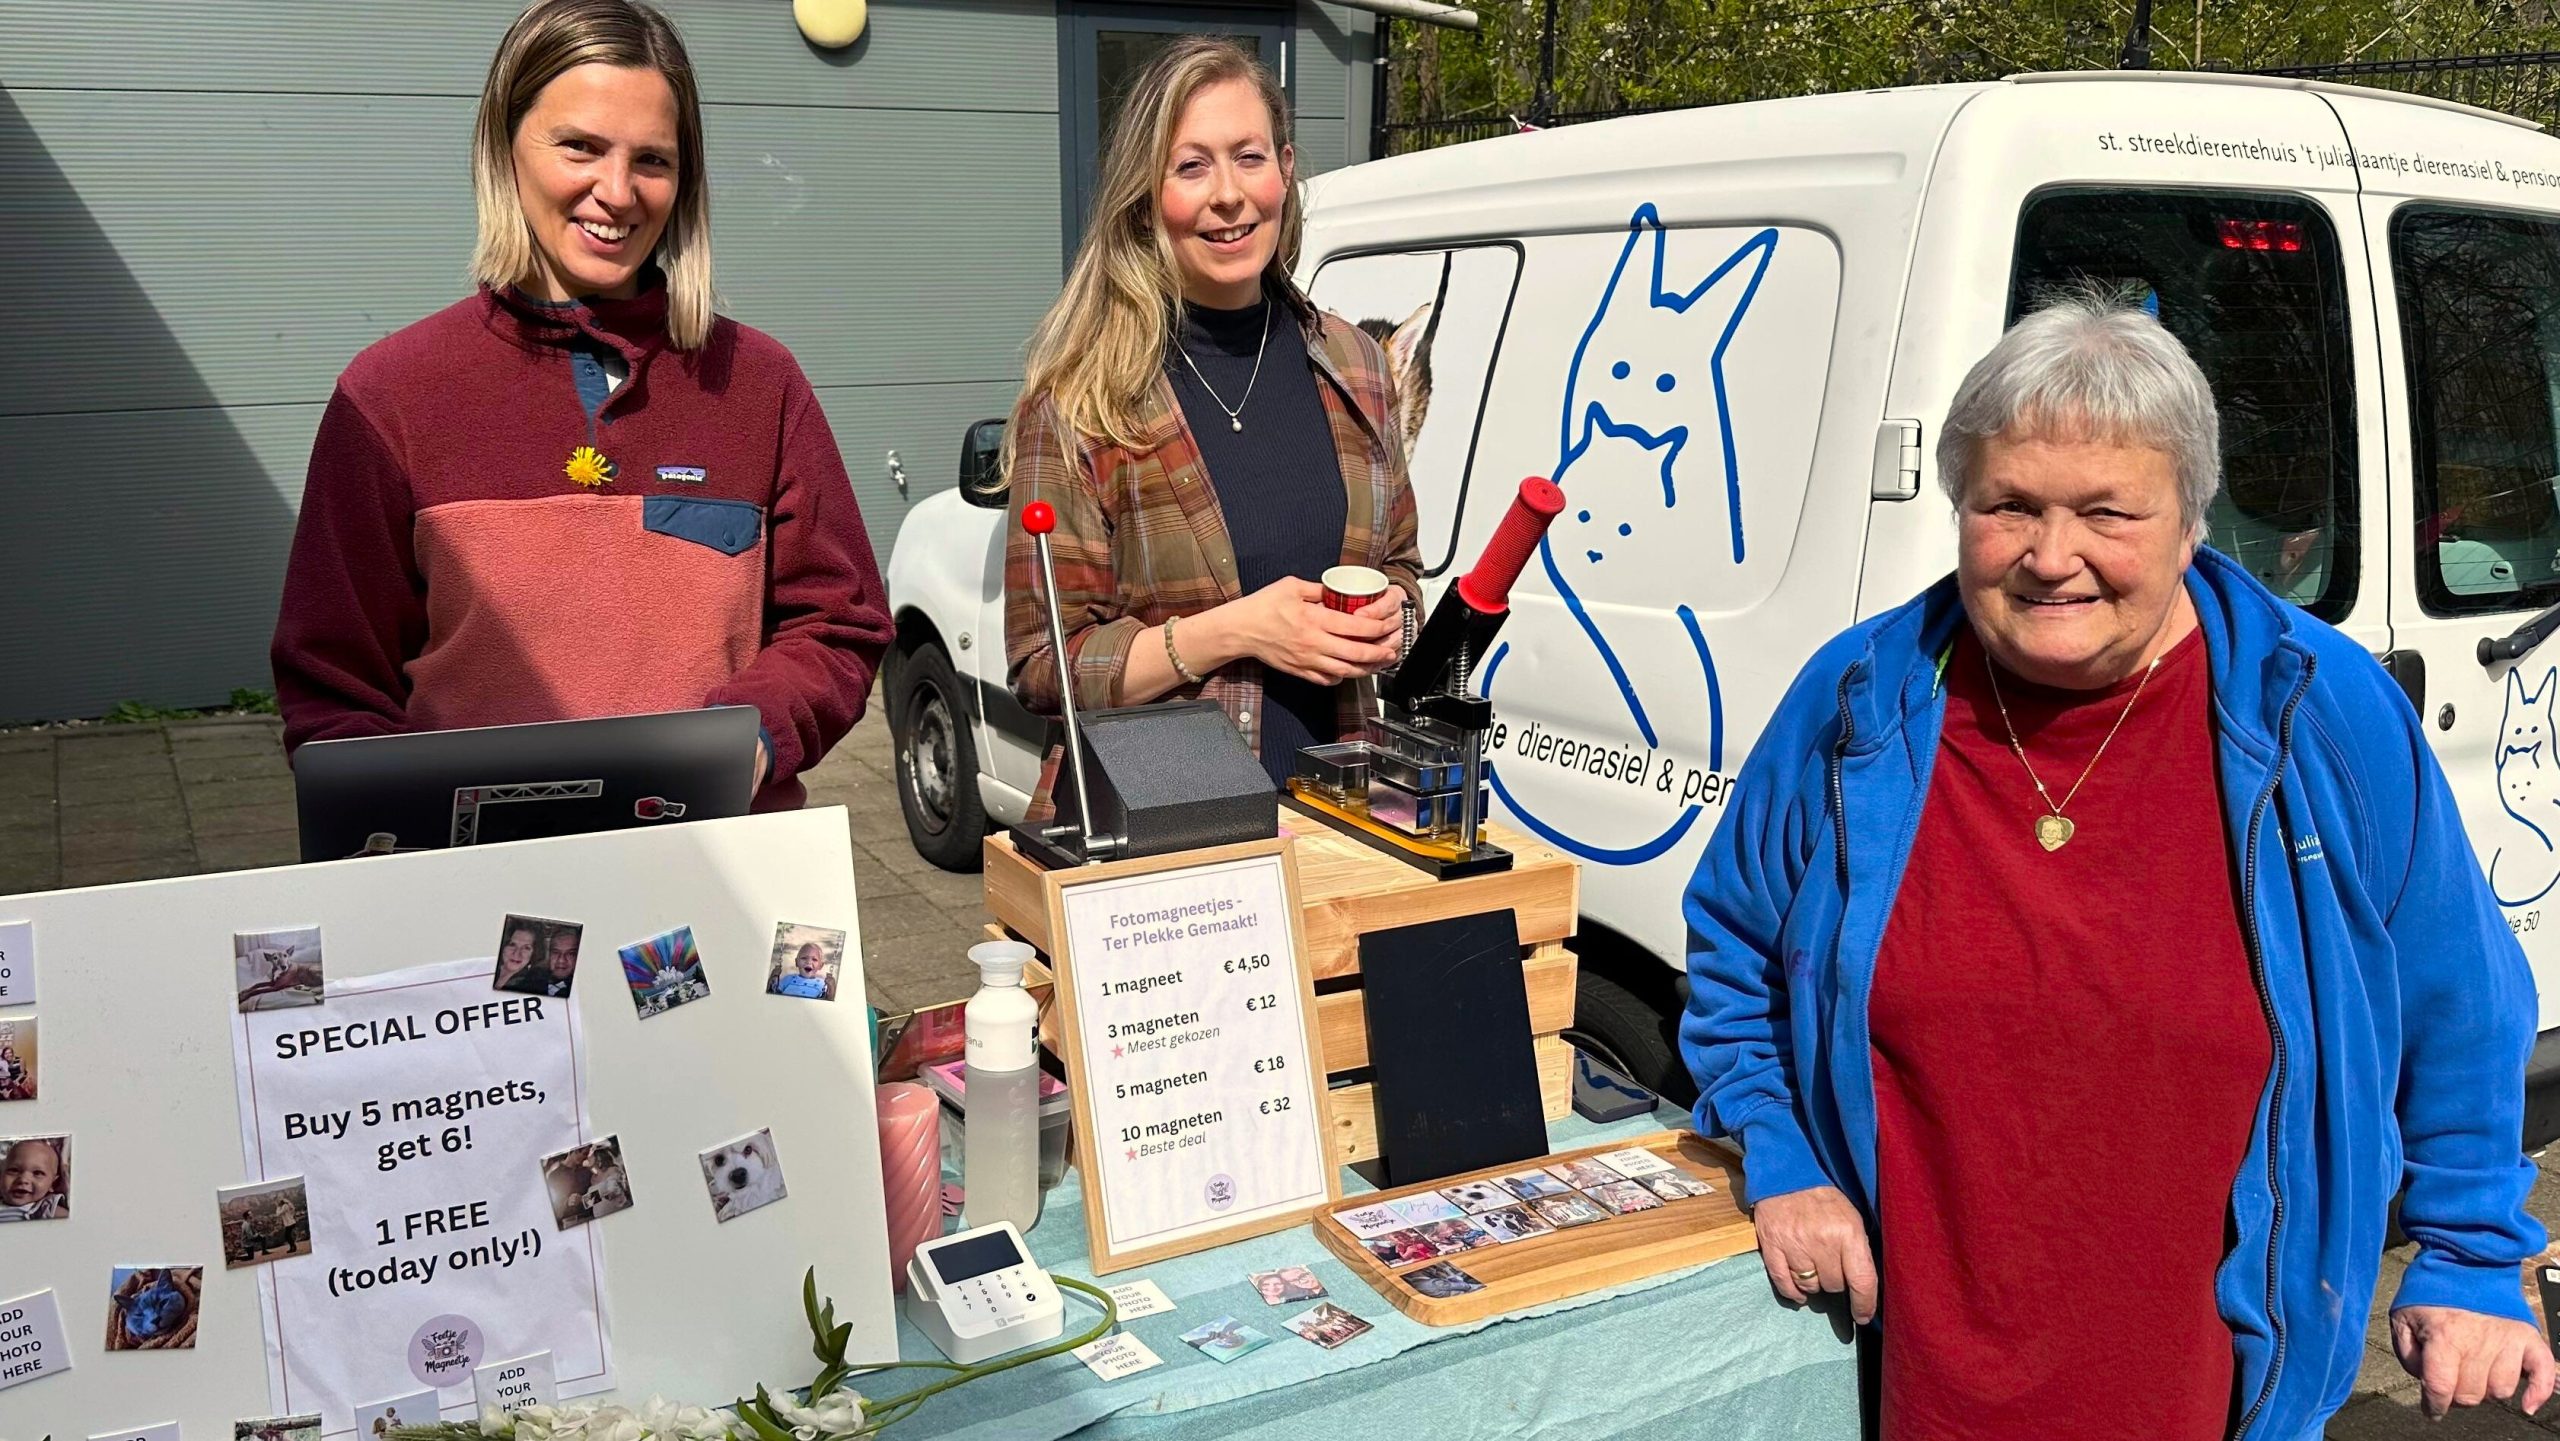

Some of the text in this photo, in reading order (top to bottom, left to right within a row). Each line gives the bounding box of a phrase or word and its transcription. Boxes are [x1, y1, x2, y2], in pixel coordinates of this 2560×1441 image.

[2098, 132, 2123, 151] st.
[2128, 132, 2297, 163] streekdierentehuis
[2300, 143, 2315, 165] 't
[2414, 152, 2493, 180] dierenasiel
[2496, 161, 2510, 182] &
[1517, 721, 1651, 787] dierenasiel
[1656, 758, 1674, 794] &
[1110, 898, 1234, 929] Fotomagneetjes
[2523, 910, 2540, 932] 50
[1102, 913, 1258, 951] Ter Plekke Gemaakt!
[1102, 953, 1270, 997] 1 magneet € 4,50
[275, 996, 545, 1059] SPECIAL OFFER
[1108, 994, 1277, 1038] 3 magneten € 12
[1127, 1027, 1220, 1054] Meest gekozen
[1116, 1055, 1285, 1099] 5 magneten € 18
[284, 1079, 546, 1140] Buy 5 magnets,
[1121, 1096, 1291, 1142] 10 magneten € 32
[377, 1125, 473, 1172] get 6!
[1140, 1131, 1207, 1157] Beste deal
[376, 1201, 489, 1246] 1 FREE
[328, 1228, 542, 1298] (today only!)
[1118, 1296, 1151, 1308] PHOTO
[1128, 1303, 1155, 1314] HERE
[0, 1325, 33, 1342] OUR
[0, 1340, 42, 1361] HOTO
[424, 1354, 471, 1374] Magneetje
[1102, 1351, 1137, 1365] PHOTO
[1115, 1358, 1143, 1371] HERE
[3, 1358, 43, 1380] HERE
[498, 1367, 526, 1382] ADD
[496, 1382, 531, 1398] YOUR
